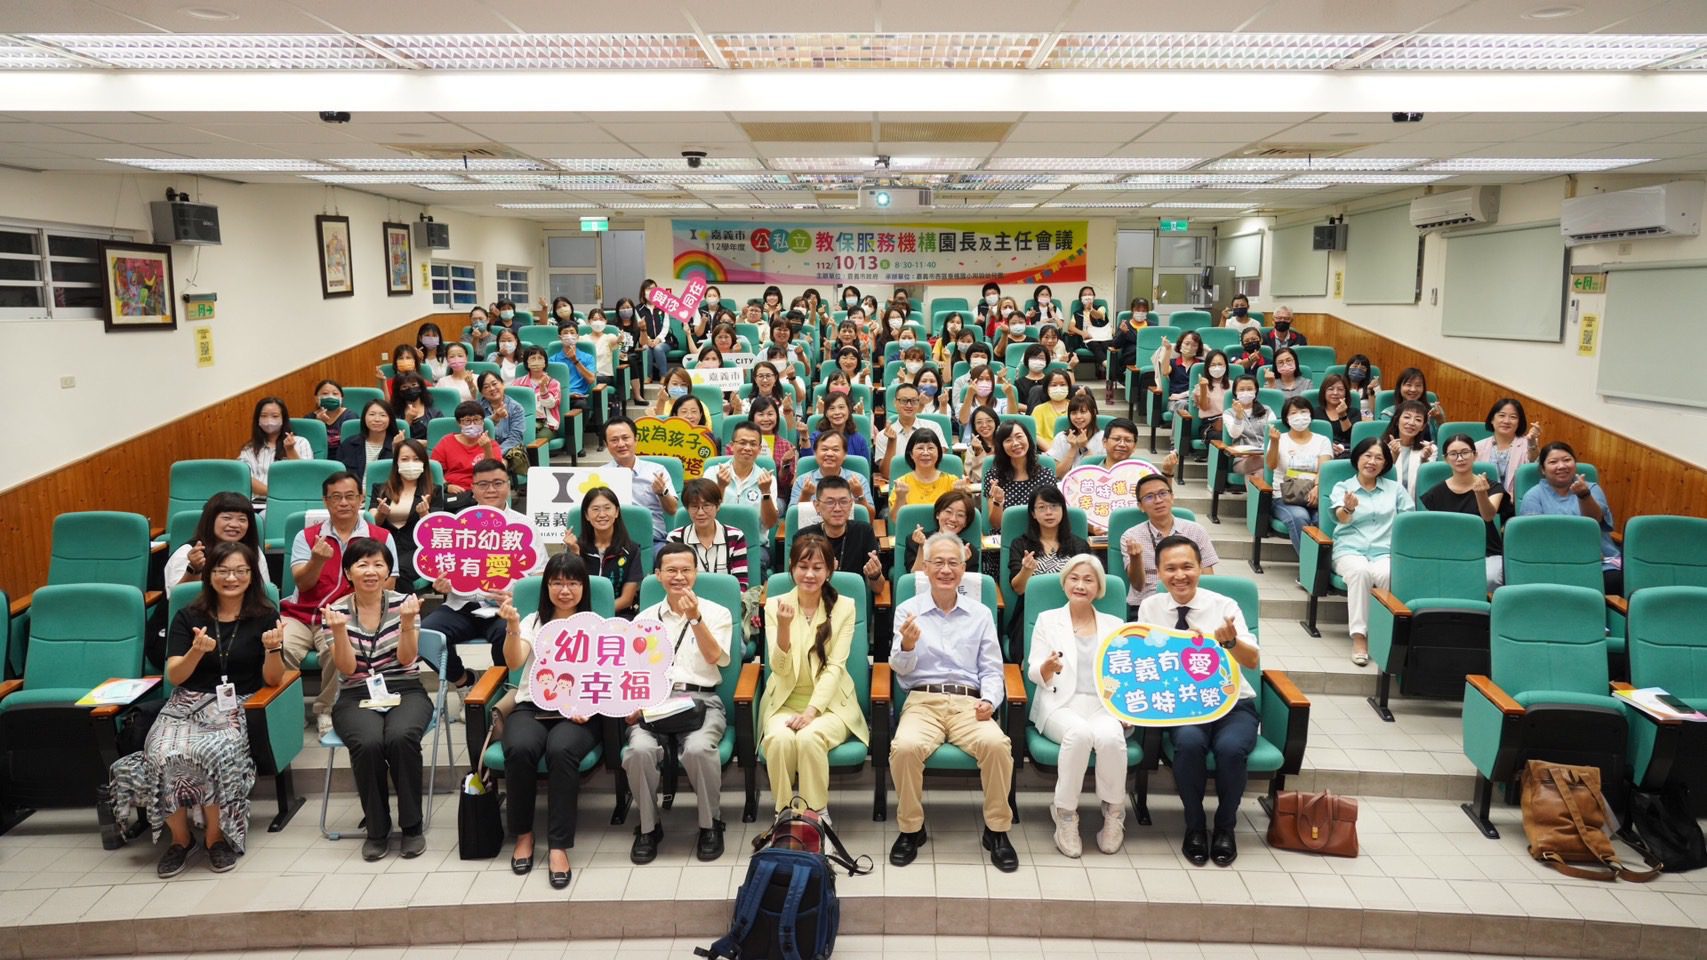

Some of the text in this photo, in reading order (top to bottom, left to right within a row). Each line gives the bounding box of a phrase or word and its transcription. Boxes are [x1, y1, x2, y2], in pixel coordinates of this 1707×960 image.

[815, 229, 1073, 253] 教保服務機構園長及主任會議
[652, 290, 680, 312] 與你
[735, 357, 754, 365] CITY
[430, 527, 524, 551] 嘉市幼教
[435, 553, 512, 579] 特有愛
[554, 629, 627, 667] 幼見
[1106, 649, 1213, 683] 嘉義有愛
[579, 670, 652, 704] 幸福
[1125, 683, 1222, 714] 普特共榮
